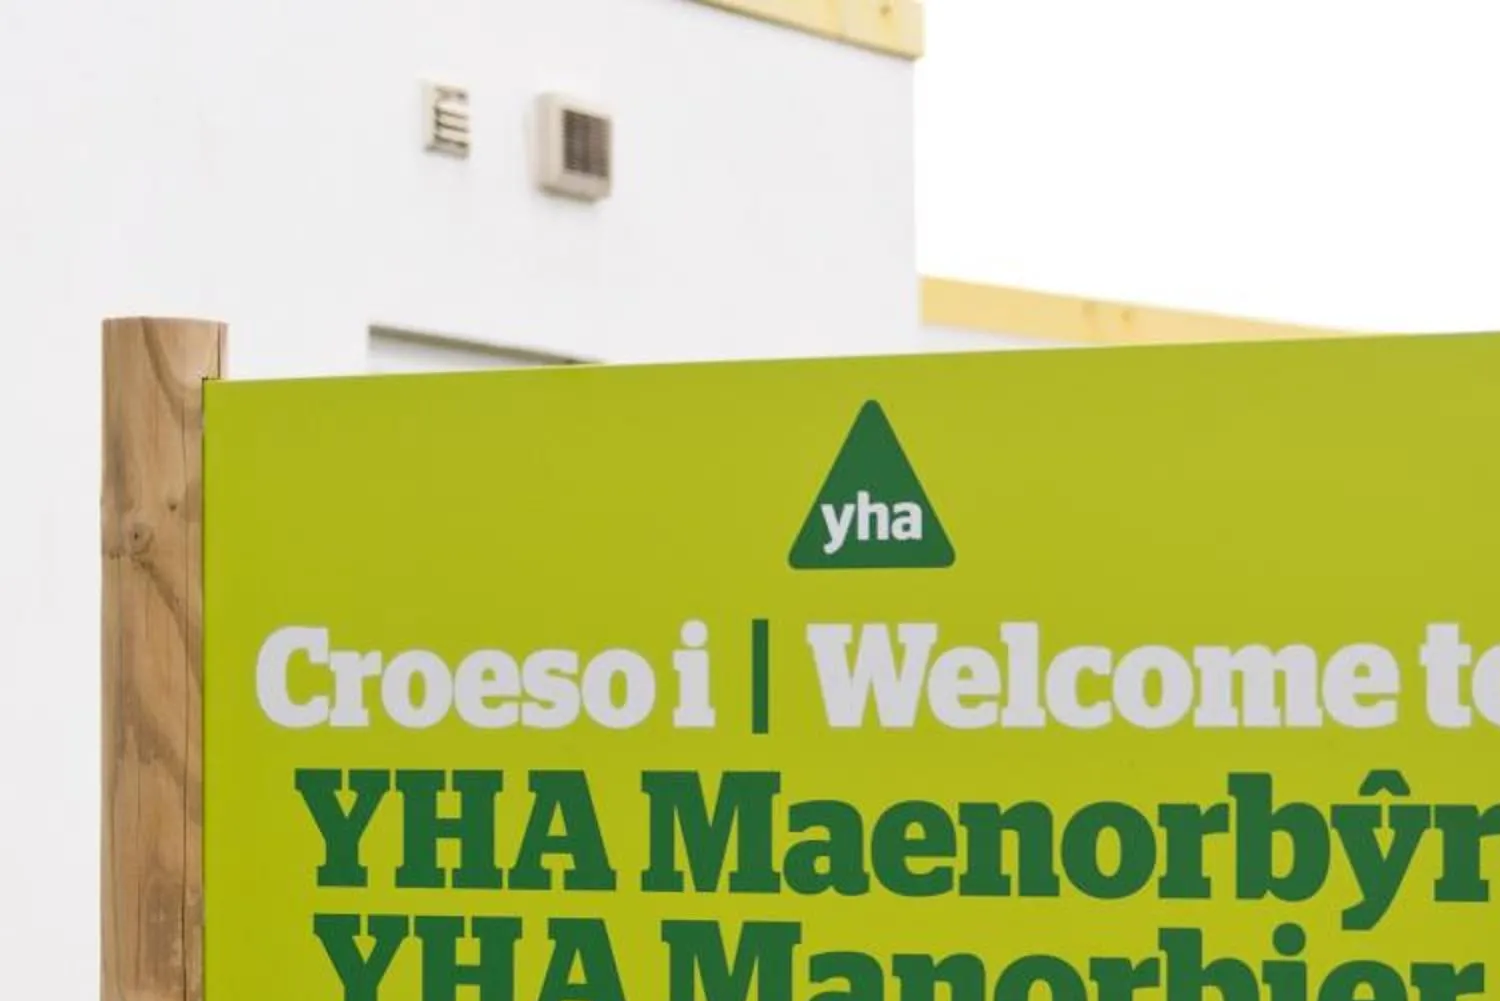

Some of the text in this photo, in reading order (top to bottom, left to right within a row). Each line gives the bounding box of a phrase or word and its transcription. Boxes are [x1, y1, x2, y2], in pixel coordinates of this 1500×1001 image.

[821, 490, 922, 553] yha
[255, 620, 715, 730] Croeso i
[806, 621, 1400, 730] Welcome
[293, 767, 617, 892] YHA
